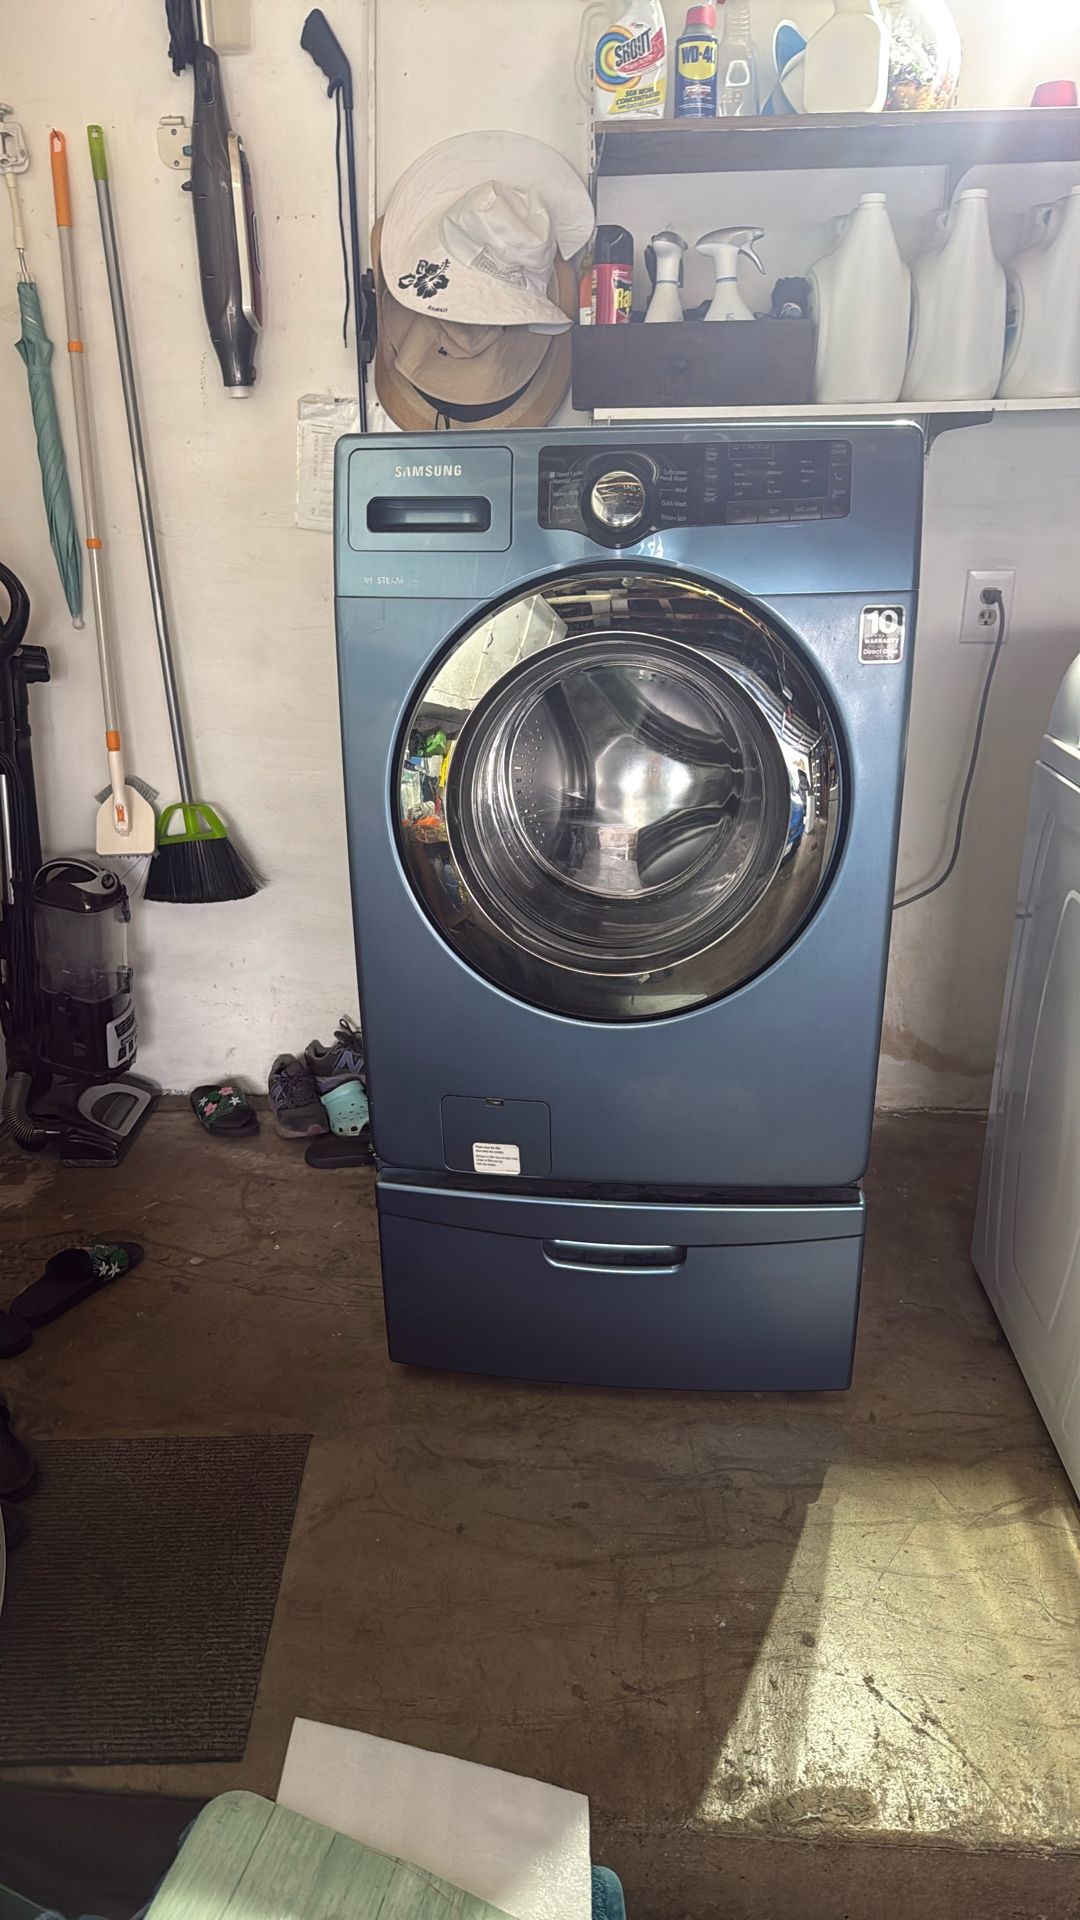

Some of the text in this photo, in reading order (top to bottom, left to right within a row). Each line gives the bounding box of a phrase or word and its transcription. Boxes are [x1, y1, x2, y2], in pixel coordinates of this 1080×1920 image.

[614, 28, 651, 67] SHOUT
[615, 286, 632, 310] Rai
[394, 464, 462, 478] SAMSUNG
[865, 609, 899, 634] 10
